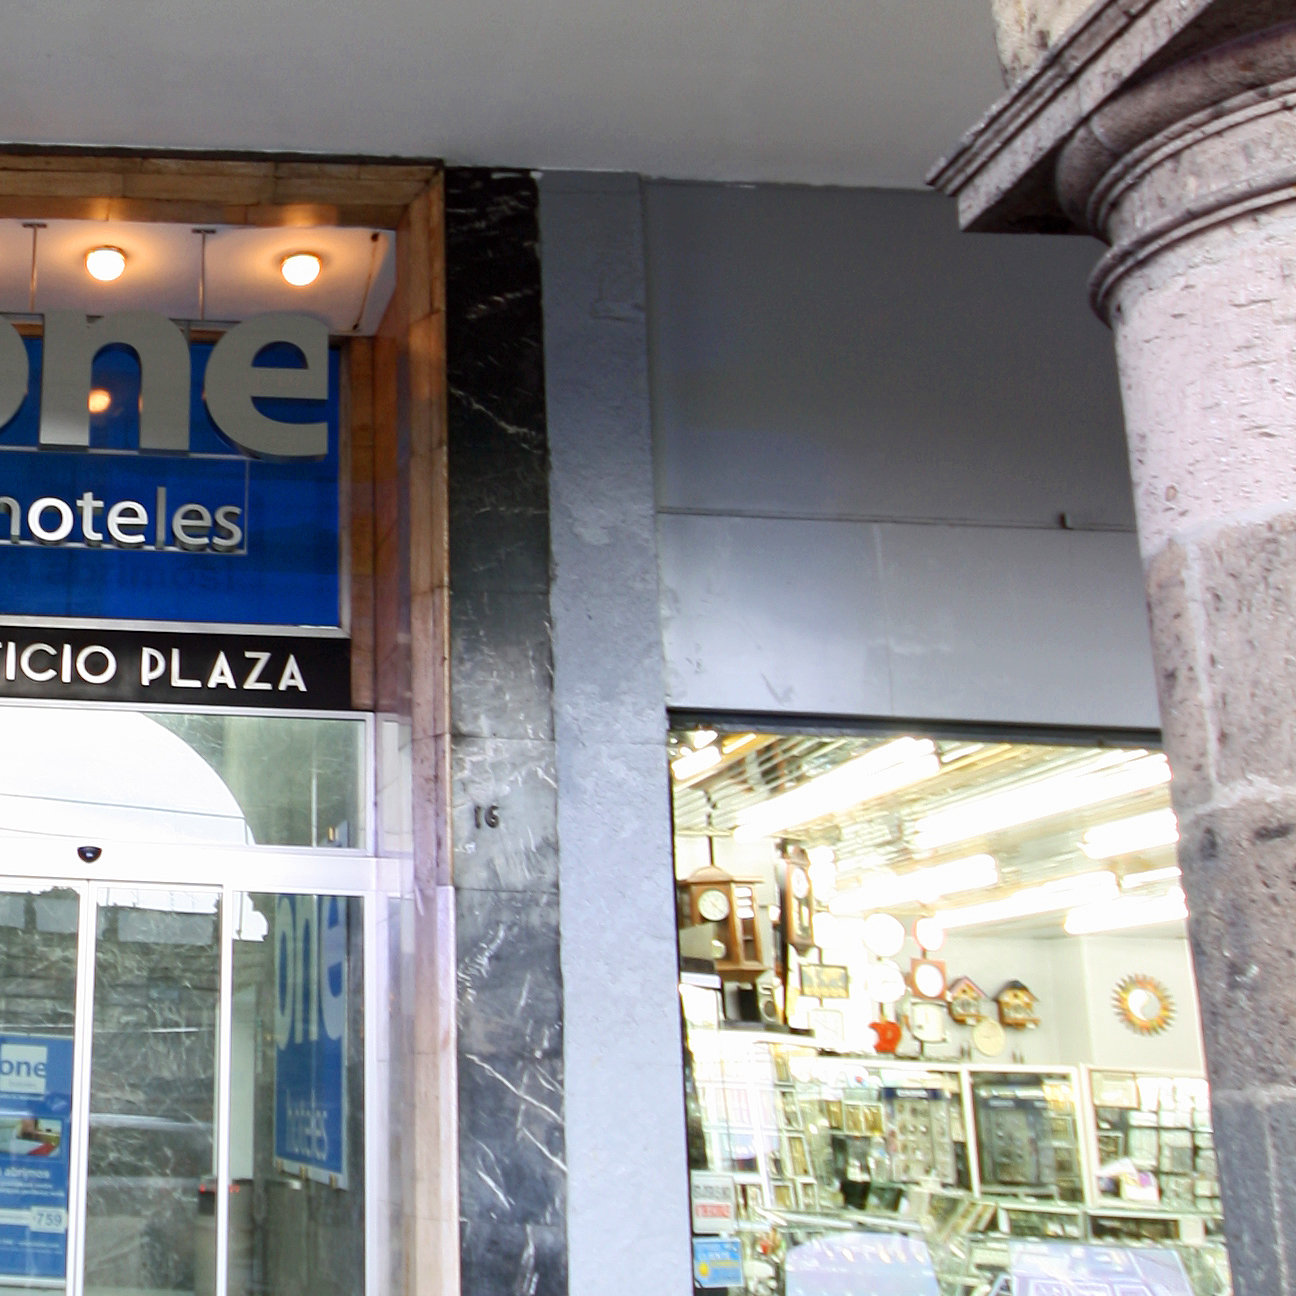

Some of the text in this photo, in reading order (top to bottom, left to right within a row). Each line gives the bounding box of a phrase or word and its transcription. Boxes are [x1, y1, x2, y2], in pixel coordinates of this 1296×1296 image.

[141, 647, 306, 692] PLAZA
[275, 896, 345, 1050] one
[0, 1060, 46, 1077] one
